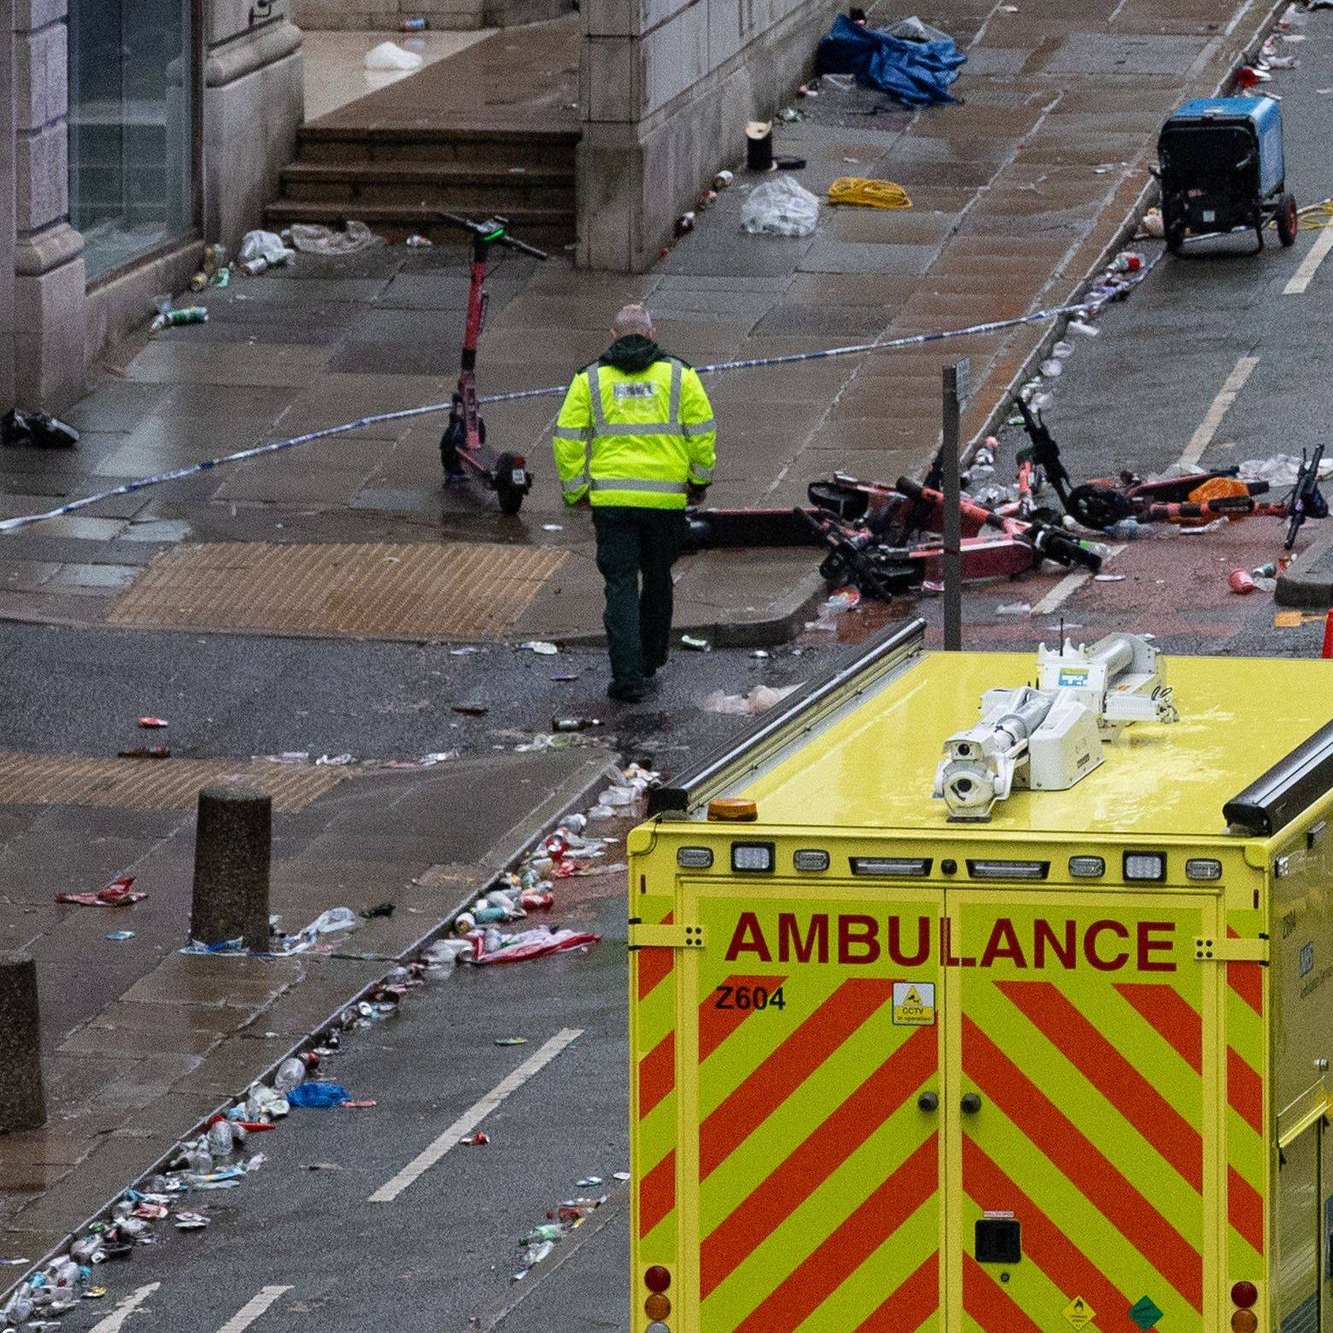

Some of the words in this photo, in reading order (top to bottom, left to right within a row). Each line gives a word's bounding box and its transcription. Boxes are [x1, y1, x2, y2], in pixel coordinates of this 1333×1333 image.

[725, 912, 1177, 971] AMBULANCE
[715, 986, 785, 1010] Z604
[902, 1007, 924, 1015] CCTV
